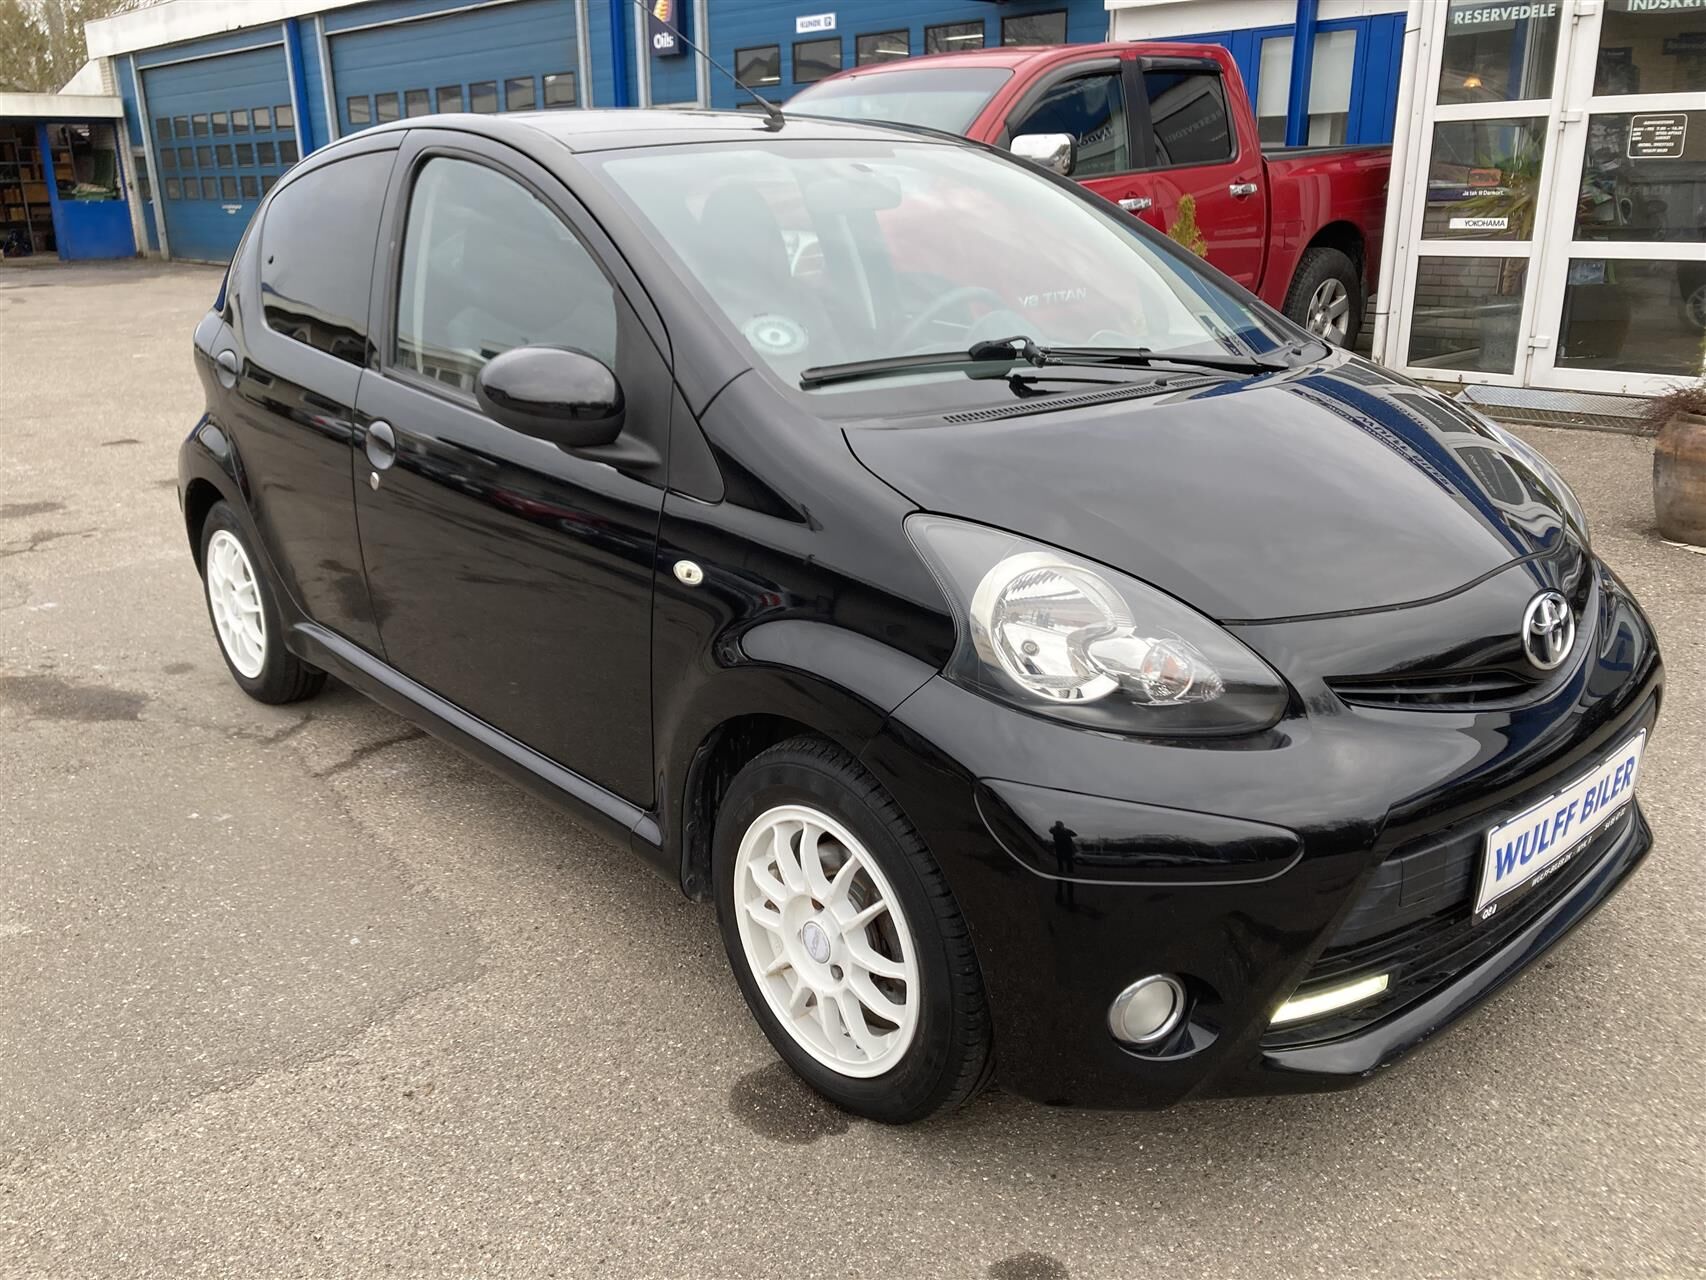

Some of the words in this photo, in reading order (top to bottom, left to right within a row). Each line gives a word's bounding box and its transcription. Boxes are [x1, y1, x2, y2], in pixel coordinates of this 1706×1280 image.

[1453, 3, 1557, 25] RESERVEDELE
[1627, 0, 1706, 11] INDSKRI
[653, 31, 674, 49] Oils
[1464, 219, 1506, 228] YOKOHAMA
[1018, 293, 1040, 308] V8
[1043, 287, 1087, 305] TITAN
[1495, 798, 1580, 883] WULFF
[1579, 755, 1636, 825] BILER
